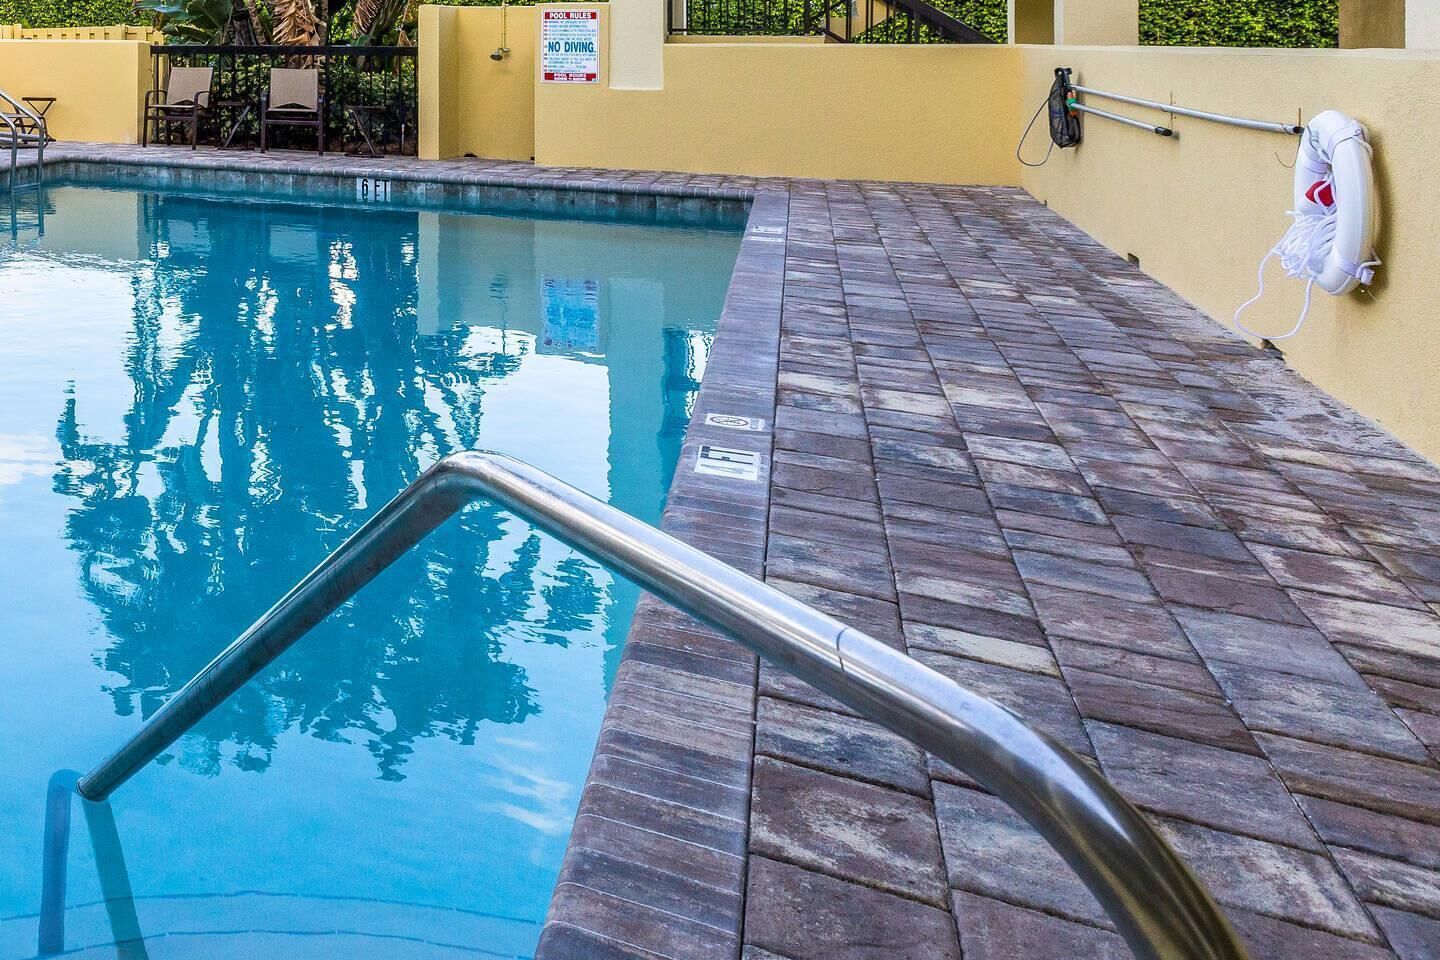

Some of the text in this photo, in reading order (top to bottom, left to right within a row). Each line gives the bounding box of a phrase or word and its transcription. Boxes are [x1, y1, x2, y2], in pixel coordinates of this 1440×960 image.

[548, 41, 560, 52] NO
[361, 178, 390, 192] 6 FT
